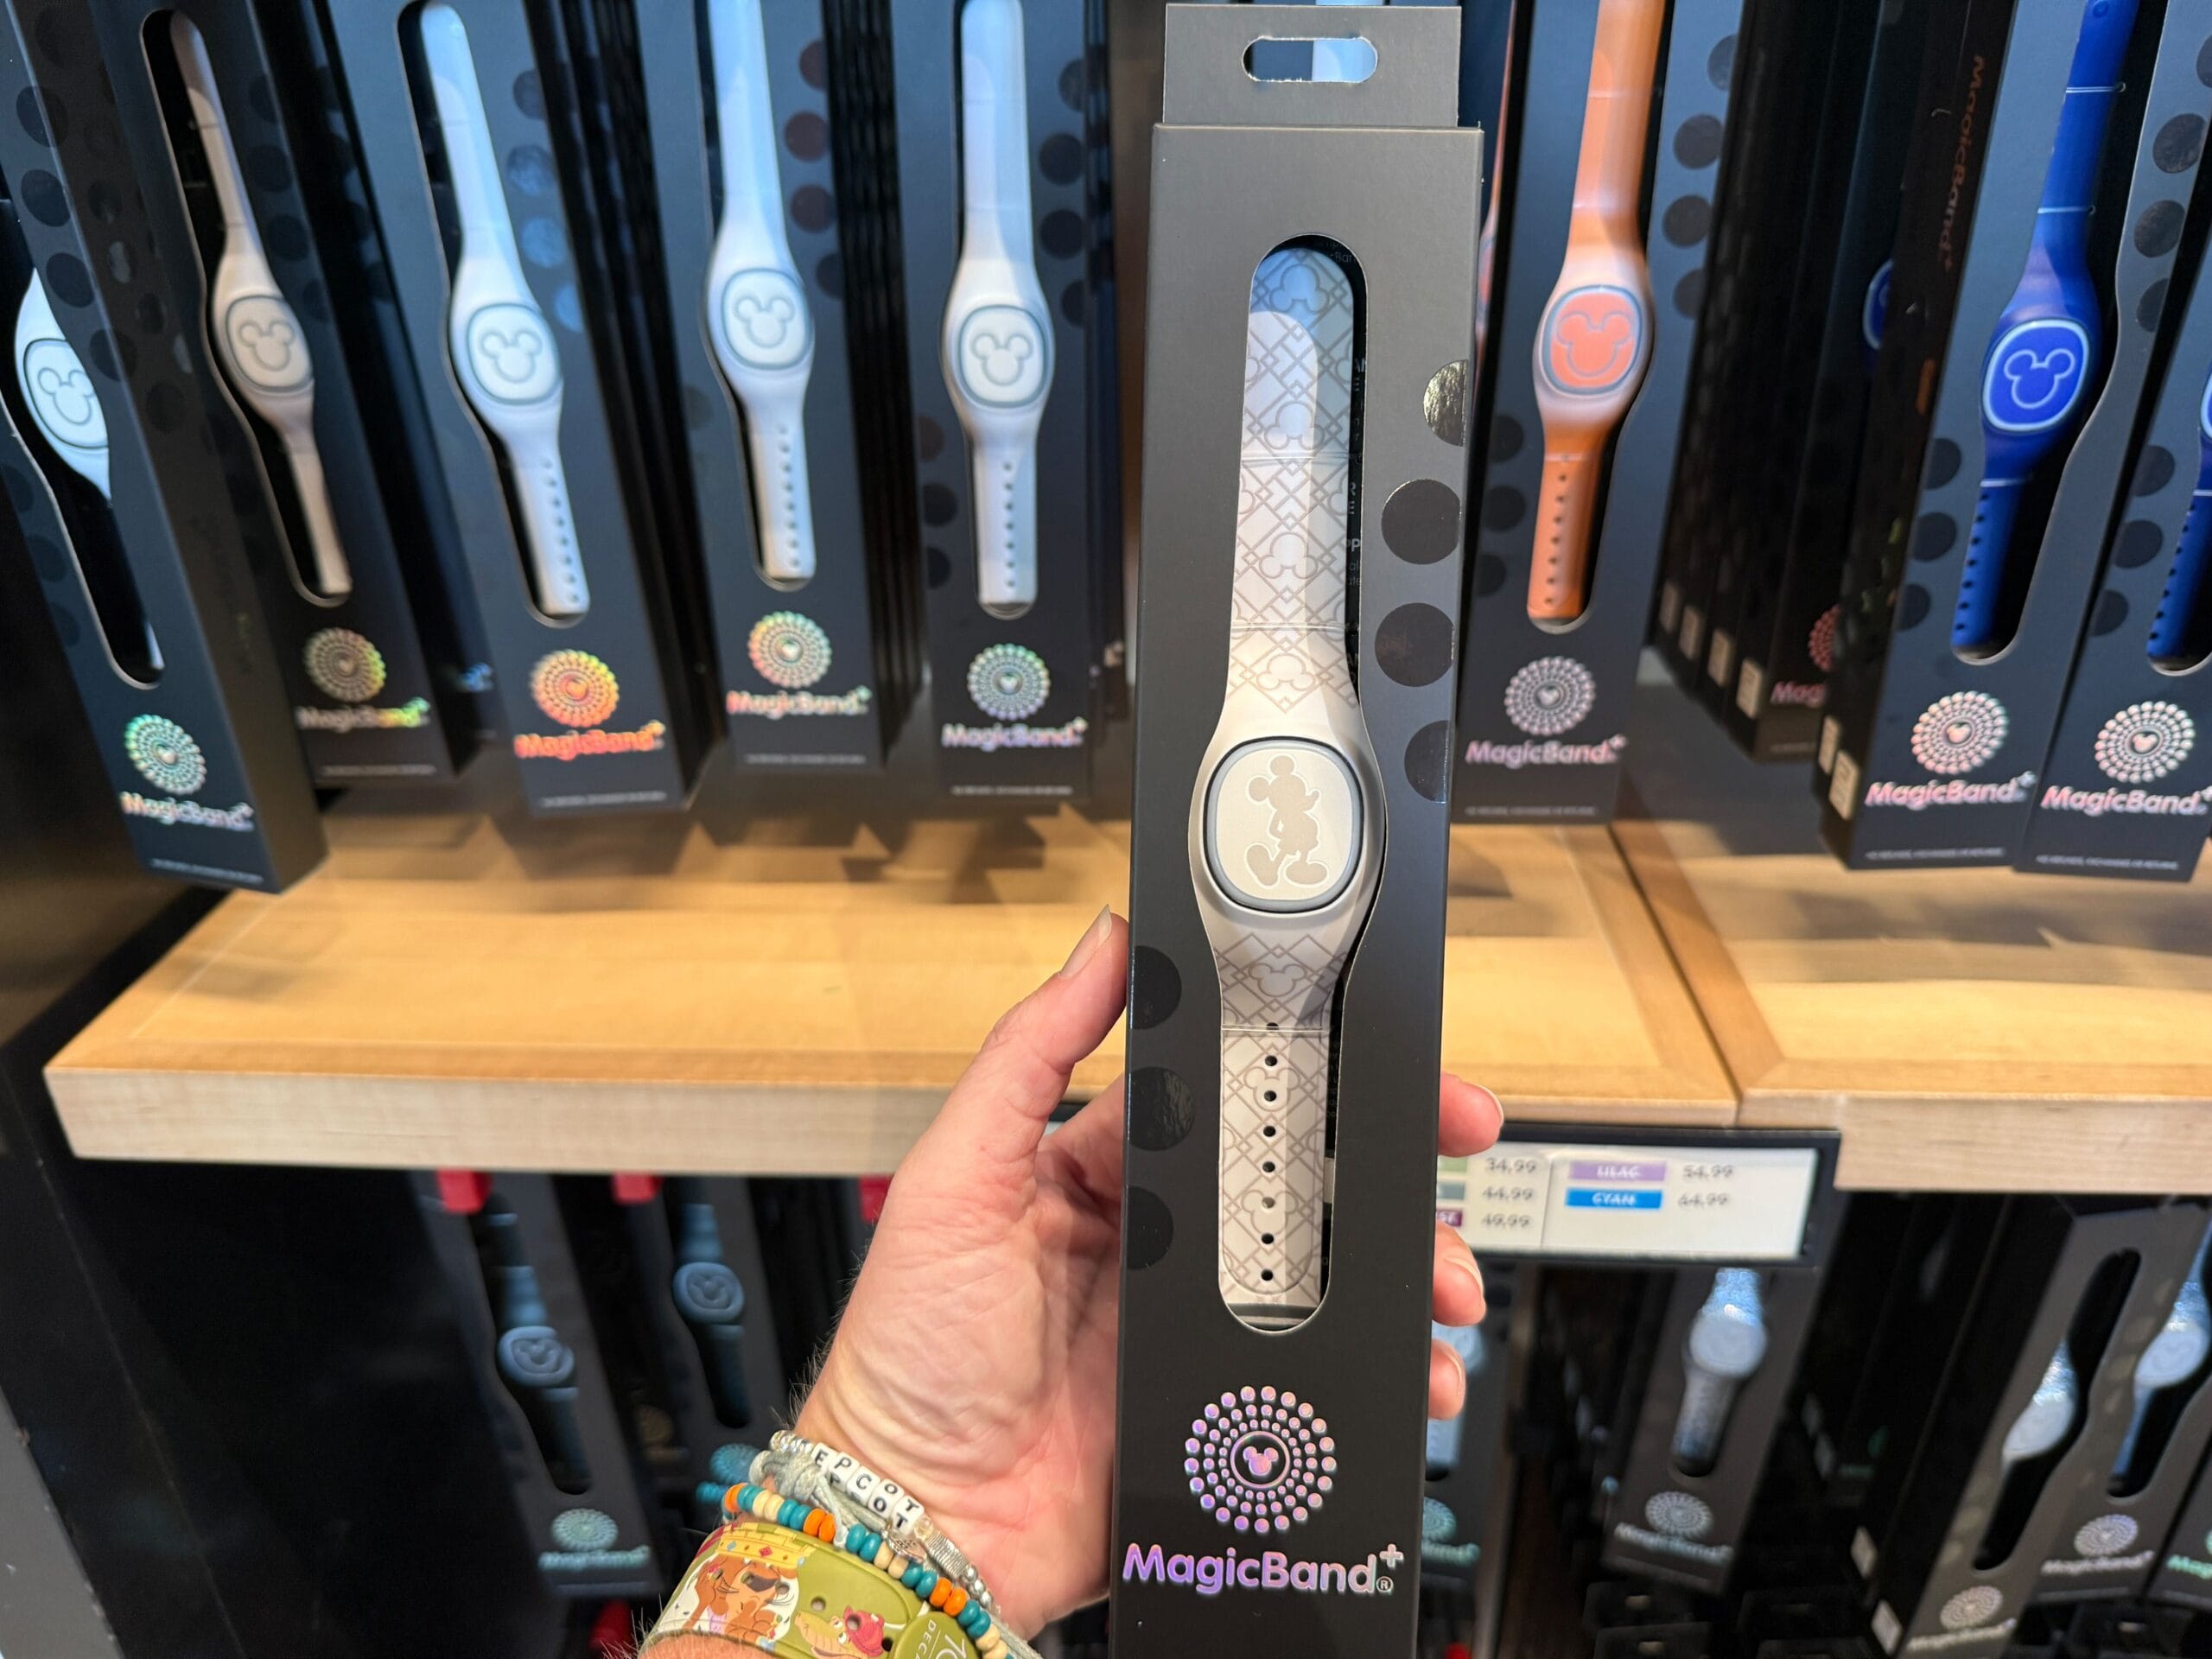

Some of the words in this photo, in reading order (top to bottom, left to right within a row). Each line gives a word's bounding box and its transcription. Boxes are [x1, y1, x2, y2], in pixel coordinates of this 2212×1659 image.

[1597, 1165, 1642, 1179] LILAC
[1591, 1191, 1638, 1207] CYAN
[814, 1448, 920, 1512] EPCOT
